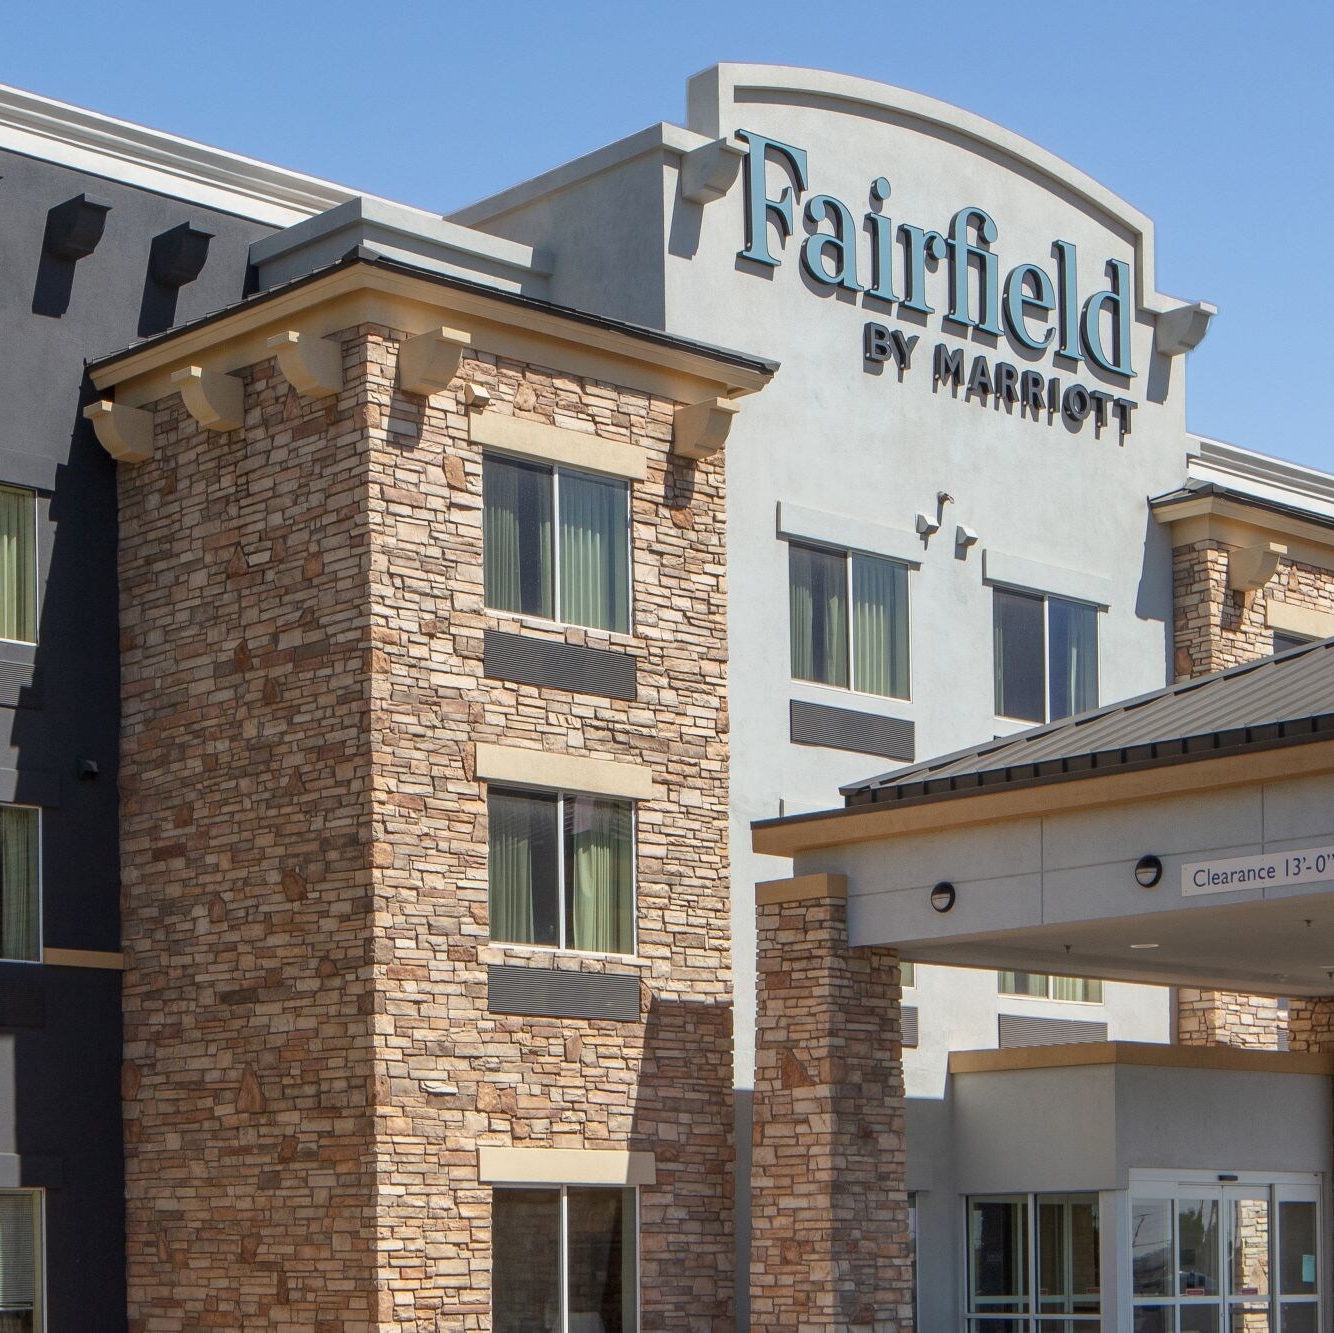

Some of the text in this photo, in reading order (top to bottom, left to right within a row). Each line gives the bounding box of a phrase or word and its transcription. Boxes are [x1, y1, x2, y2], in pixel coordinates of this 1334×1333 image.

[734, 128, 1138, 377] Fairfield
[864, 322, 1138, 435] BY MARRIOTT
[1193, 864, 1276, 887] Clearance
